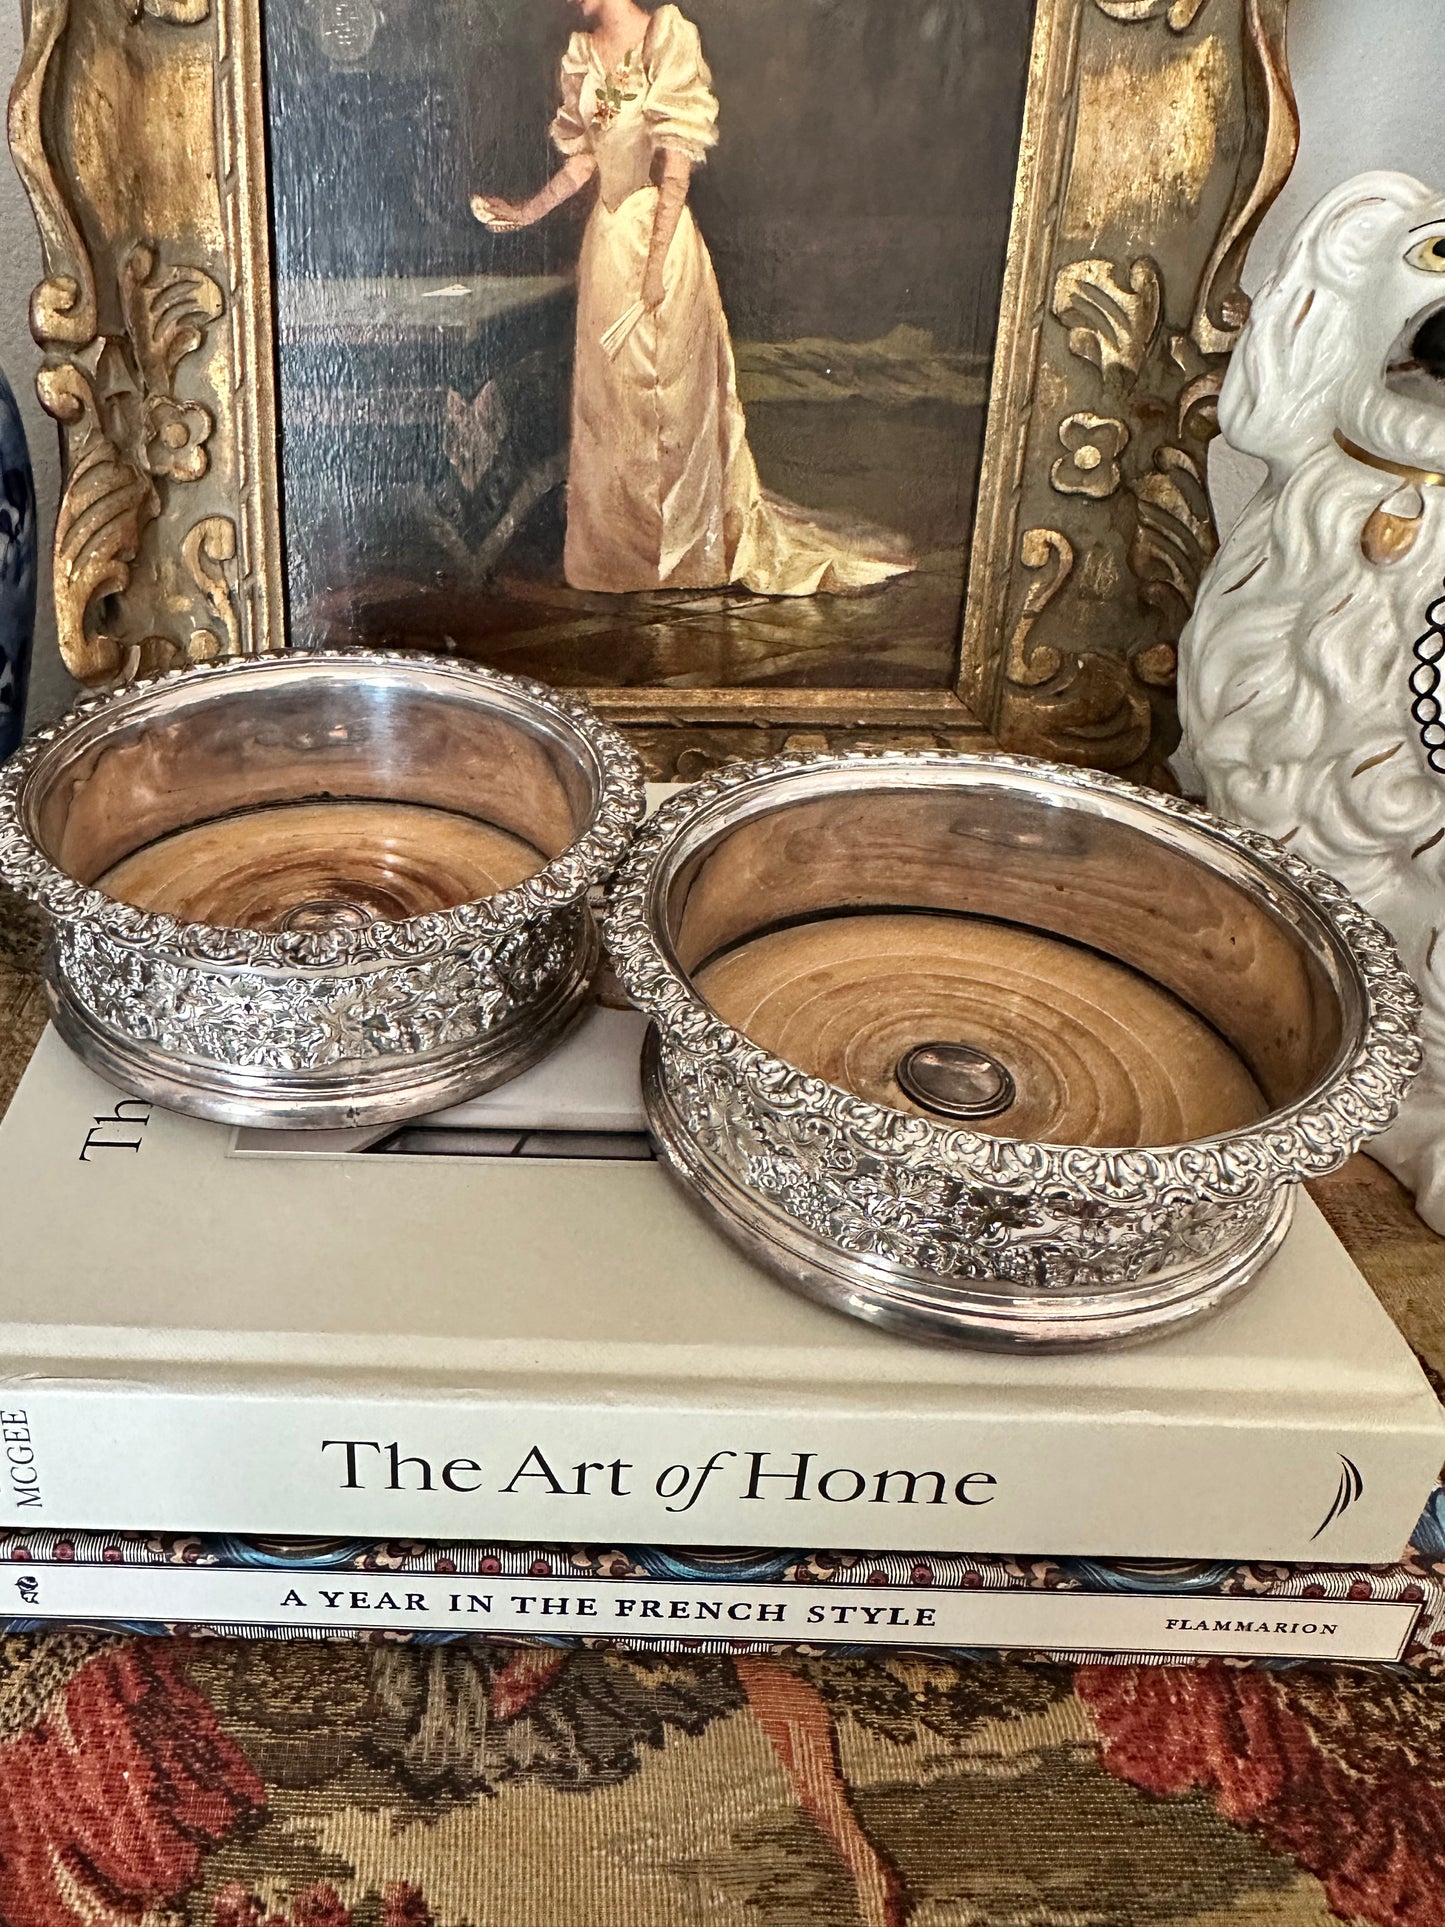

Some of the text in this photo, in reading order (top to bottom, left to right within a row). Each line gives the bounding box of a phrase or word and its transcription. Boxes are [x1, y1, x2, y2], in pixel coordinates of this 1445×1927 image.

[78, 1099, 153, 1162] Th
[0, 1409, 43, 1508] MCGEE
[321, 1440, 998, 1513] The Art of Home
[280, 1589, 937, 1627] A YEAR IN THE FRENCH STYLE
[1165, 1618, 1339, 1635] FLAMMARION
